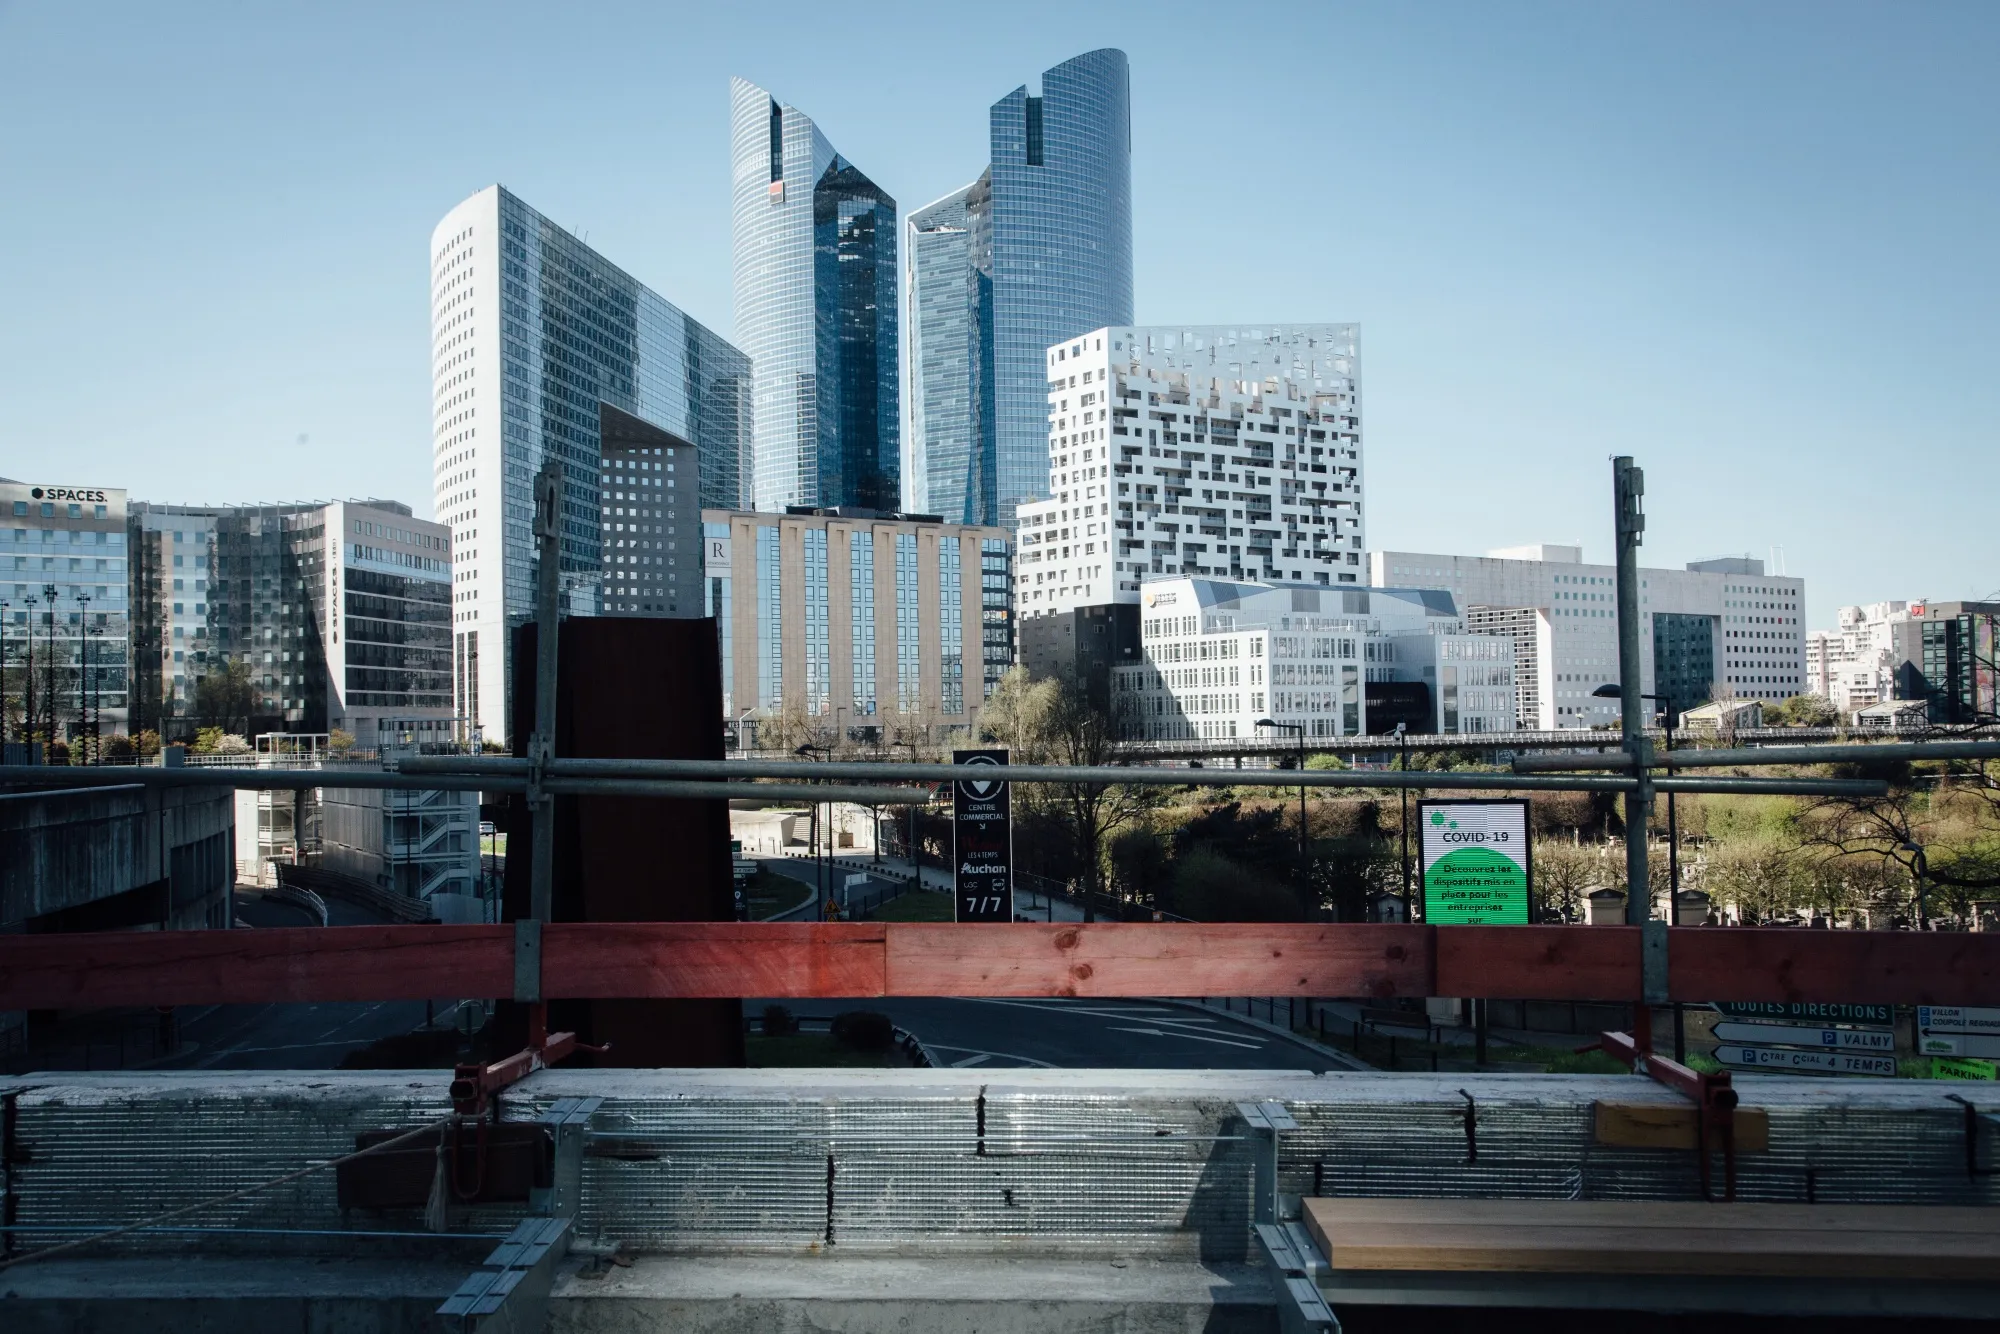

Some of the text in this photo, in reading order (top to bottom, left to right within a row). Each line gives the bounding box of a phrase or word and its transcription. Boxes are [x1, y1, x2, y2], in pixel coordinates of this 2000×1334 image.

[47, 488, 108, 503] SPACES.
[712, 542, 725, 558] R
[960, 813, 1006, 821] COMMERCIAL
[1442, 831, 1509, 843] COVID-19
[967, 851, 977, 859] LES
[982, 851, 999, 859] TEMPS
[960, 862, 1007, 874] Auchan
[1443, 864, 1512, 873] Découvrez les
[1433, 877, 1481, 888] dispositifs
[1441, 889, 1509, 900] place pour les
[966, 896, 1002, 914] 7/7
[1447, 902, 1503, 914] entreprises
[1792, 1003, 1888, 1020] DIRECTIONS
[1932, 1018, 1967, 1027] COUPOLE
[1843, 1034, 1891, 1047] VALMY
[1828, 1057, 1836, 1068] 4
[1845, 1058, 1892, 1072] TEMPS
